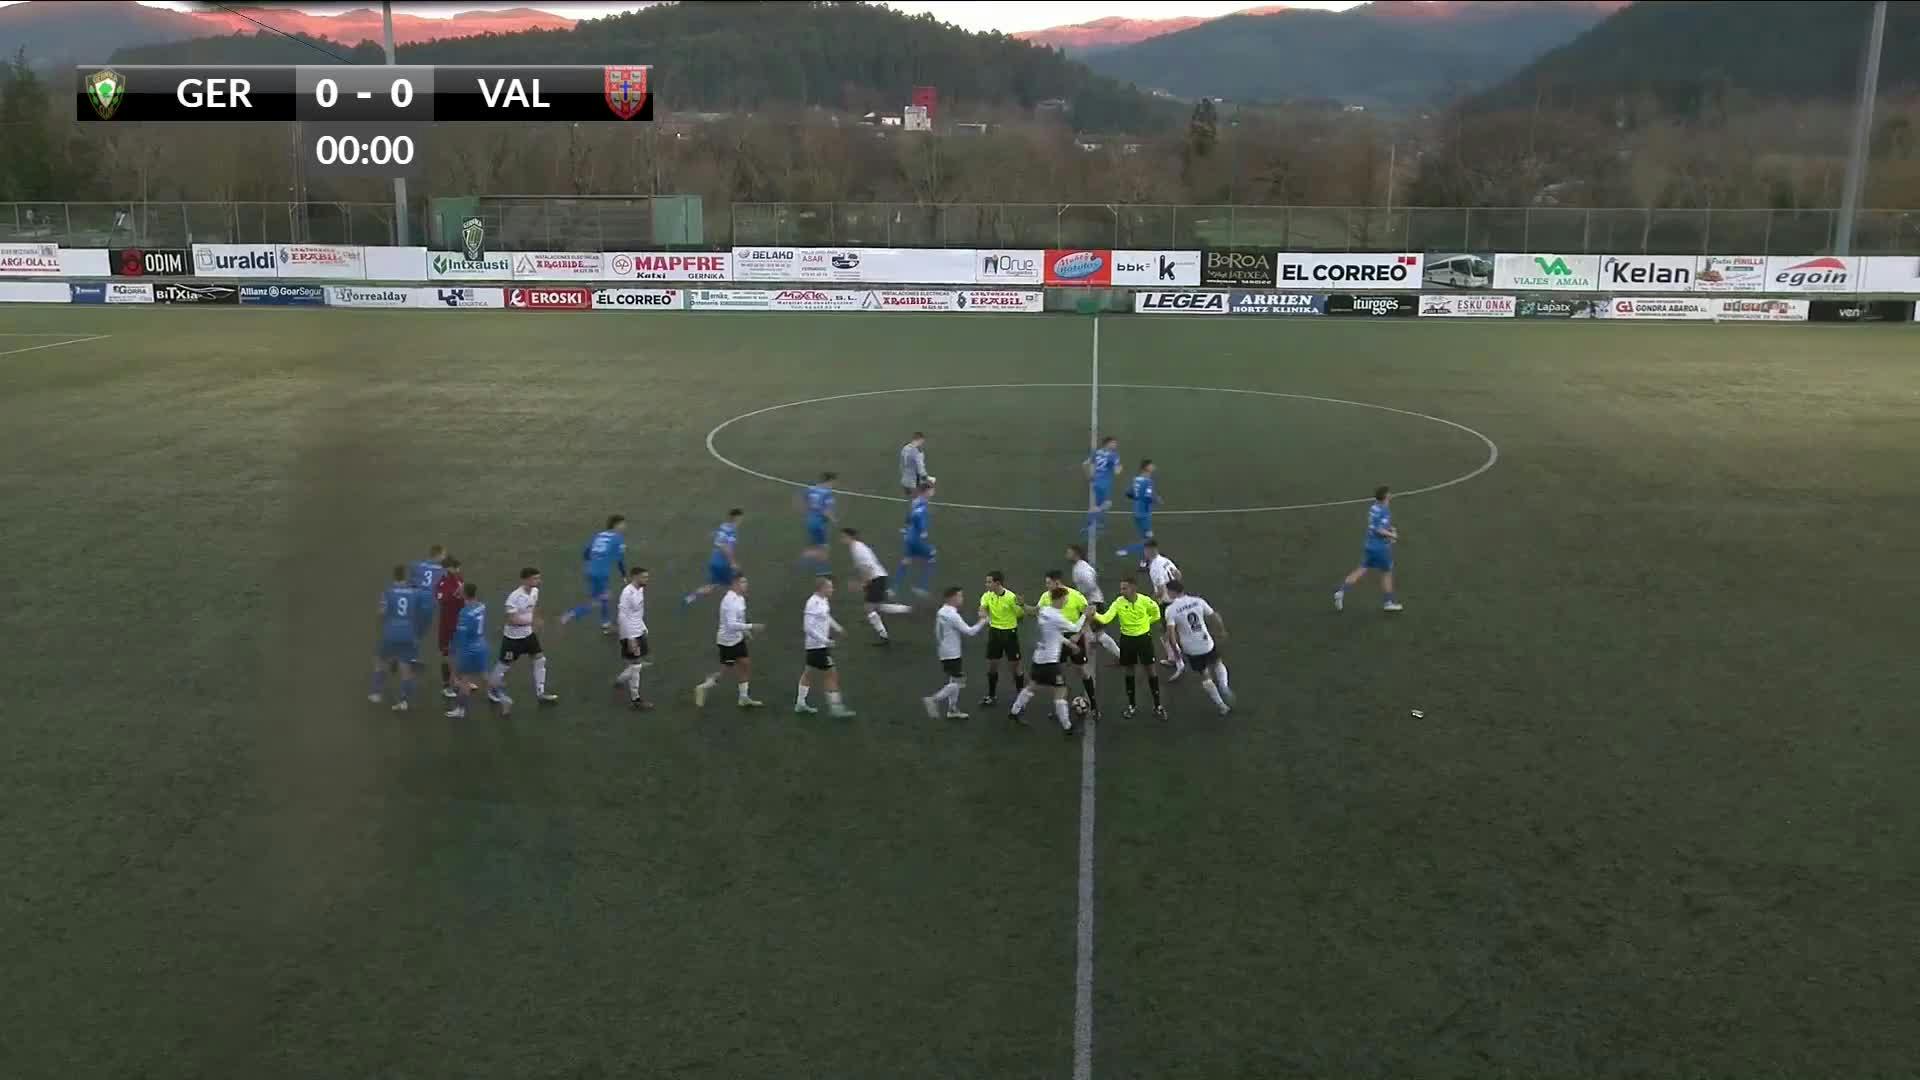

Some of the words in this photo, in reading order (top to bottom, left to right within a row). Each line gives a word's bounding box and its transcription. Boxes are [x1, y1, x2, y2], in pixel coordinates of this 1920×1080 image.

[752, 251, 794, 260] BELAKO
[145, 254, 182, 272] ODIM
[449, 259, 509, 270] Intxausti
[635, 256, 725, 271] MAPFRE
[1000, 255, 1033, 270] Orue
[1117, 263, 1145, 272] bbk
[1282, 264, 1308, 281] EL
[1313, 264, 1408, 281] CORREO
[1612, 262, 1690, 283] Kelan
[1776, 270, 1847, 286] egoin
[1513, 277, 1549, 285] VIAJES
[1556, 278, 1589, 286] AMAIA
[241, 287, 268, 295] Allianz
[531, 292, 582, 304] EROSKI
[598, 294, 615, 305] EL
[616, 294, 672, 305] CORREO
[1143, 293, 1224, 309] LEGEA
[1240, 294, 1312, 305] ARRIEN
[1353, 296, 1399, 315] iturgges
[1457, 300, 1482, 310] ESKU
[1485, 300, 1512, 310] ONAK
[1635, 304, 1667, 312] GONDRA
[422, 570, 433, 586] 3
[396, 597, 409, 616] 9
